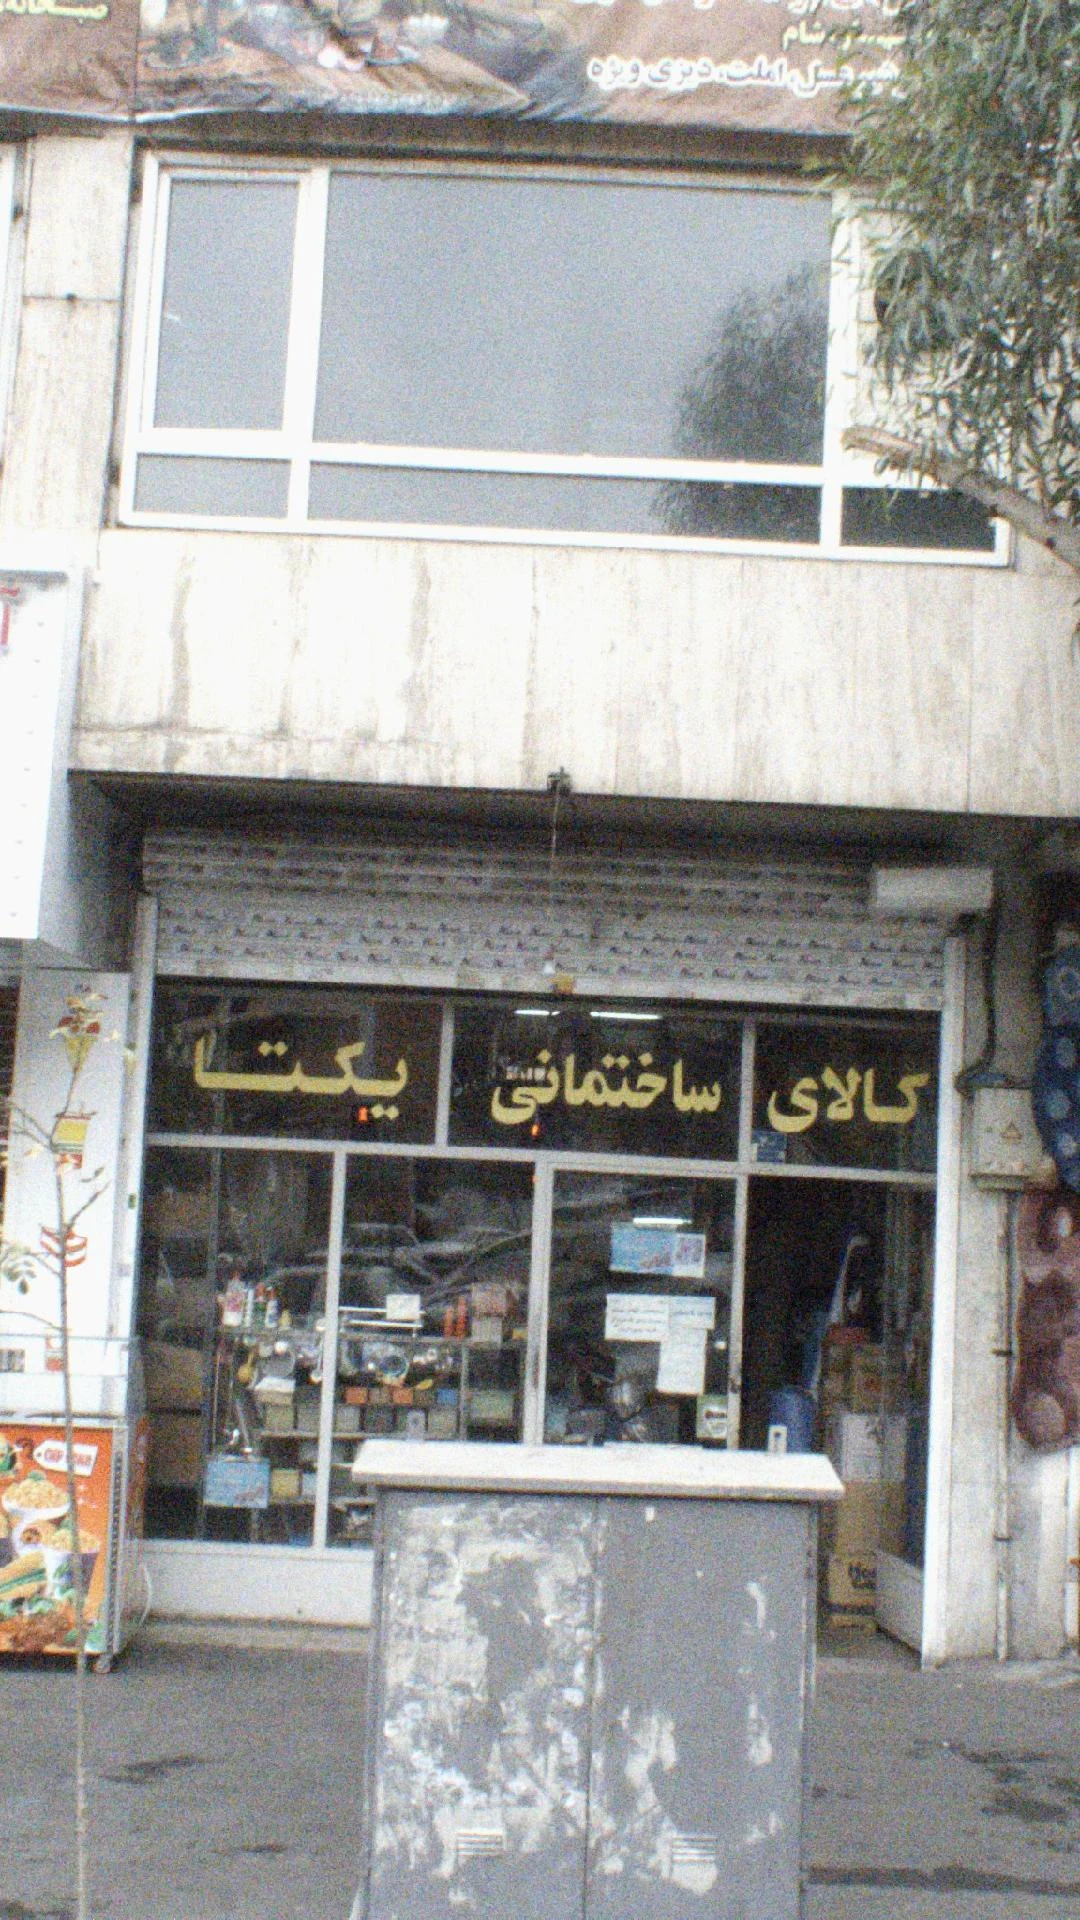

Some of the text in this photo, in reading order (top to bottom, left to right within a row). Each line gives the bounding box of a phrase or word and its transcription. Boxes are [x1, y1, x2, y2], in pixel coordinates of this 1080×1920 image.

[192, 1034, 929, 1133] کالای ساختمانی یکتا
